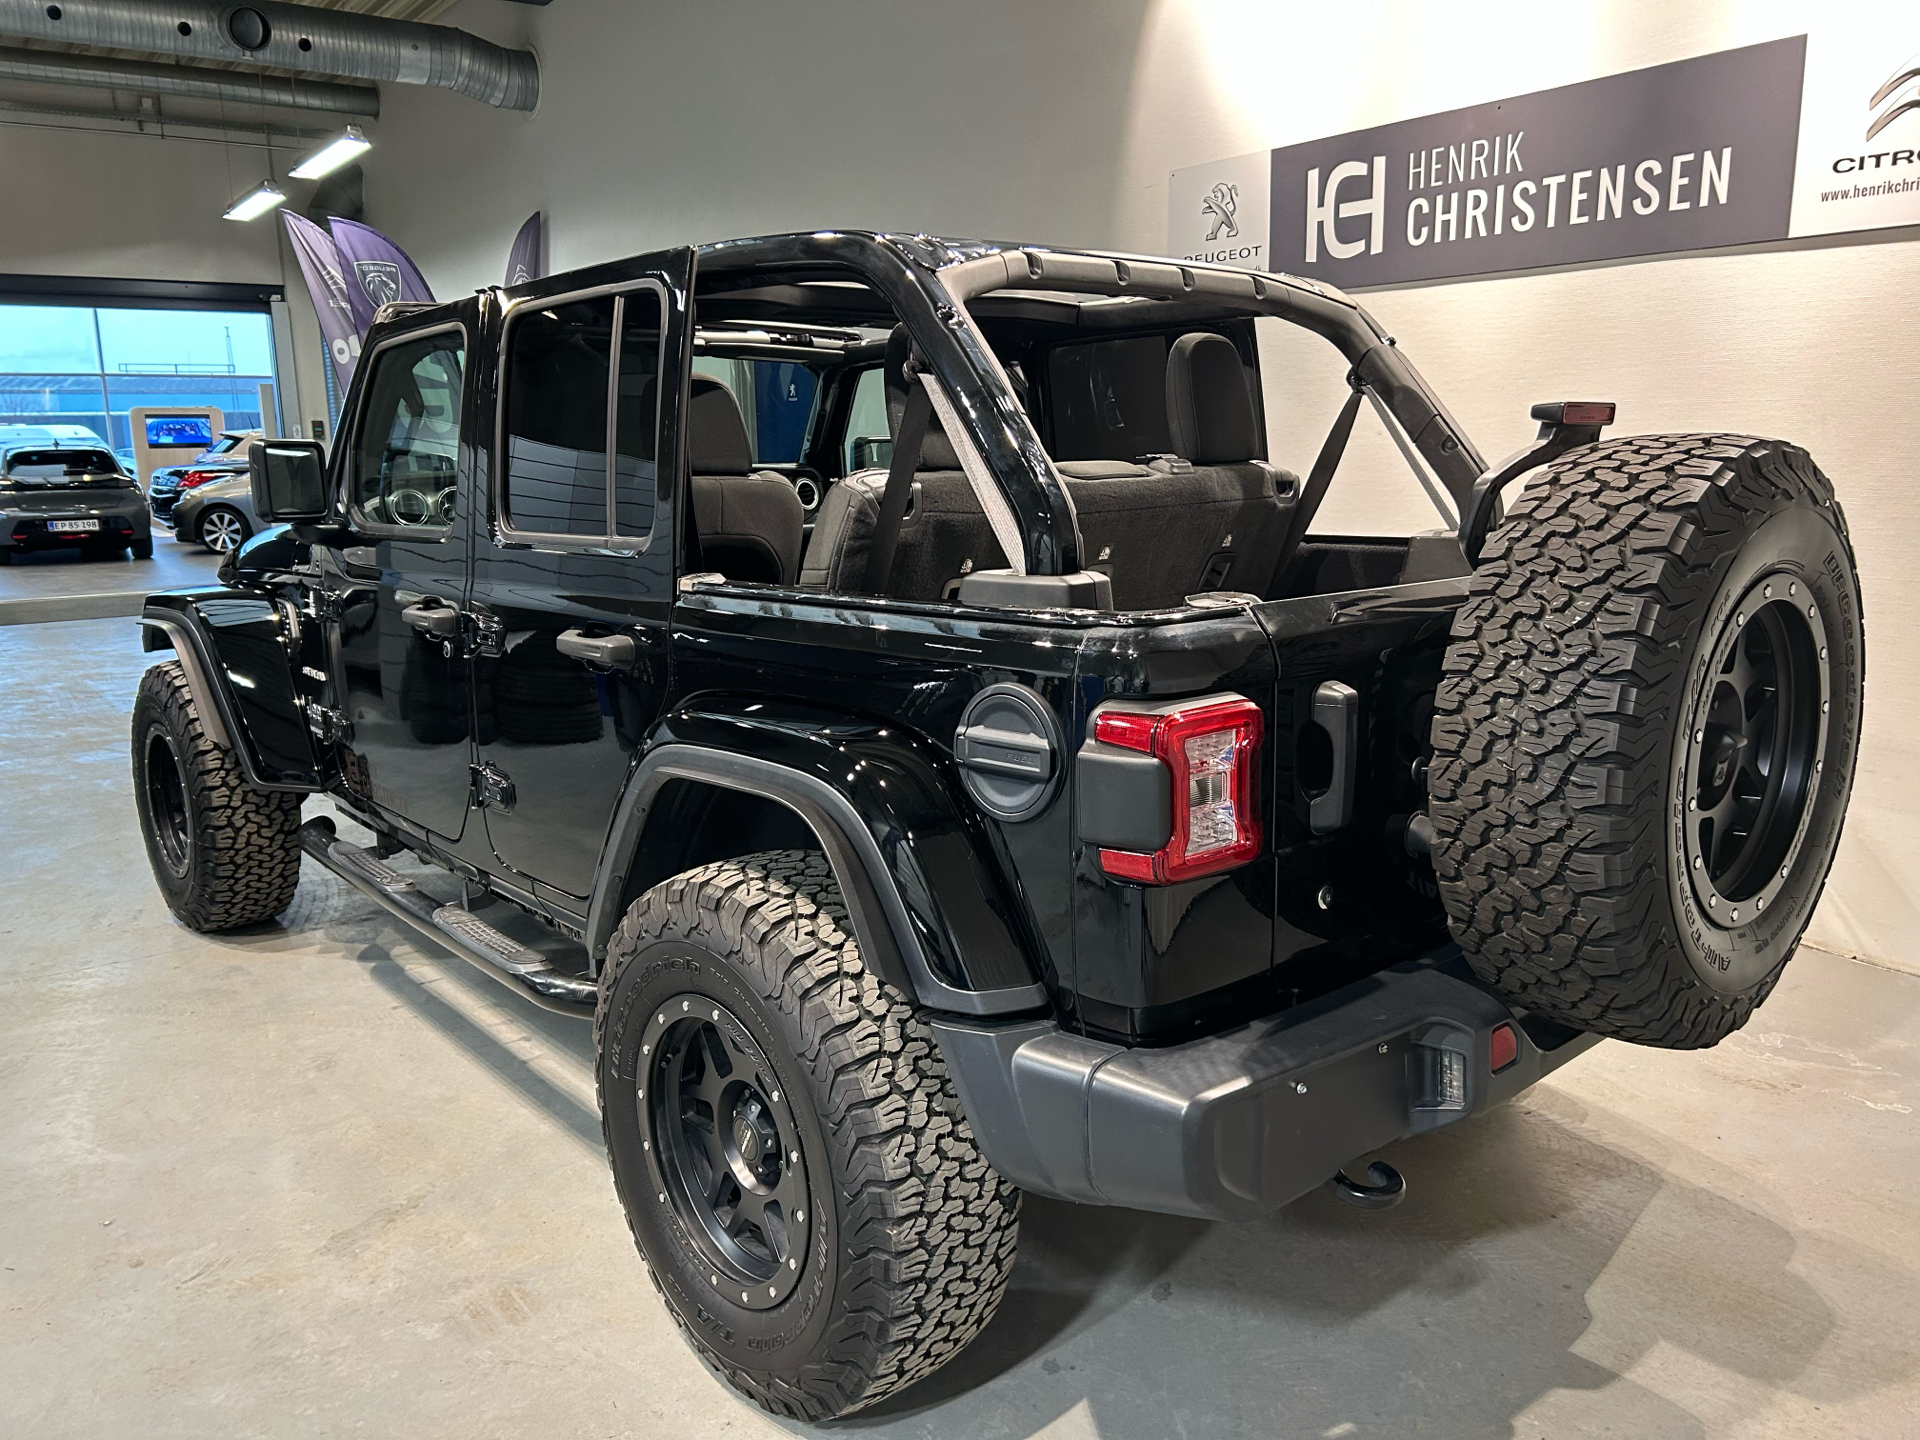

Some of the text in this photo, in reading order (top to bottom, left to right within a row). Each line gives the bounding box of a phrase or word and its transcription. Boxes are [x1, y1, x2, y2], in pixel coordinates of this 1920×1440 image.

[1408, 131, 1524, 191] HENRIK
[1832, 149, 1920, 174] CITR
[1406, 147, 1732, 247] CHRISTENSEN
[54, 522, 67, 530] EP
[82, 521, 97, 529] 198
